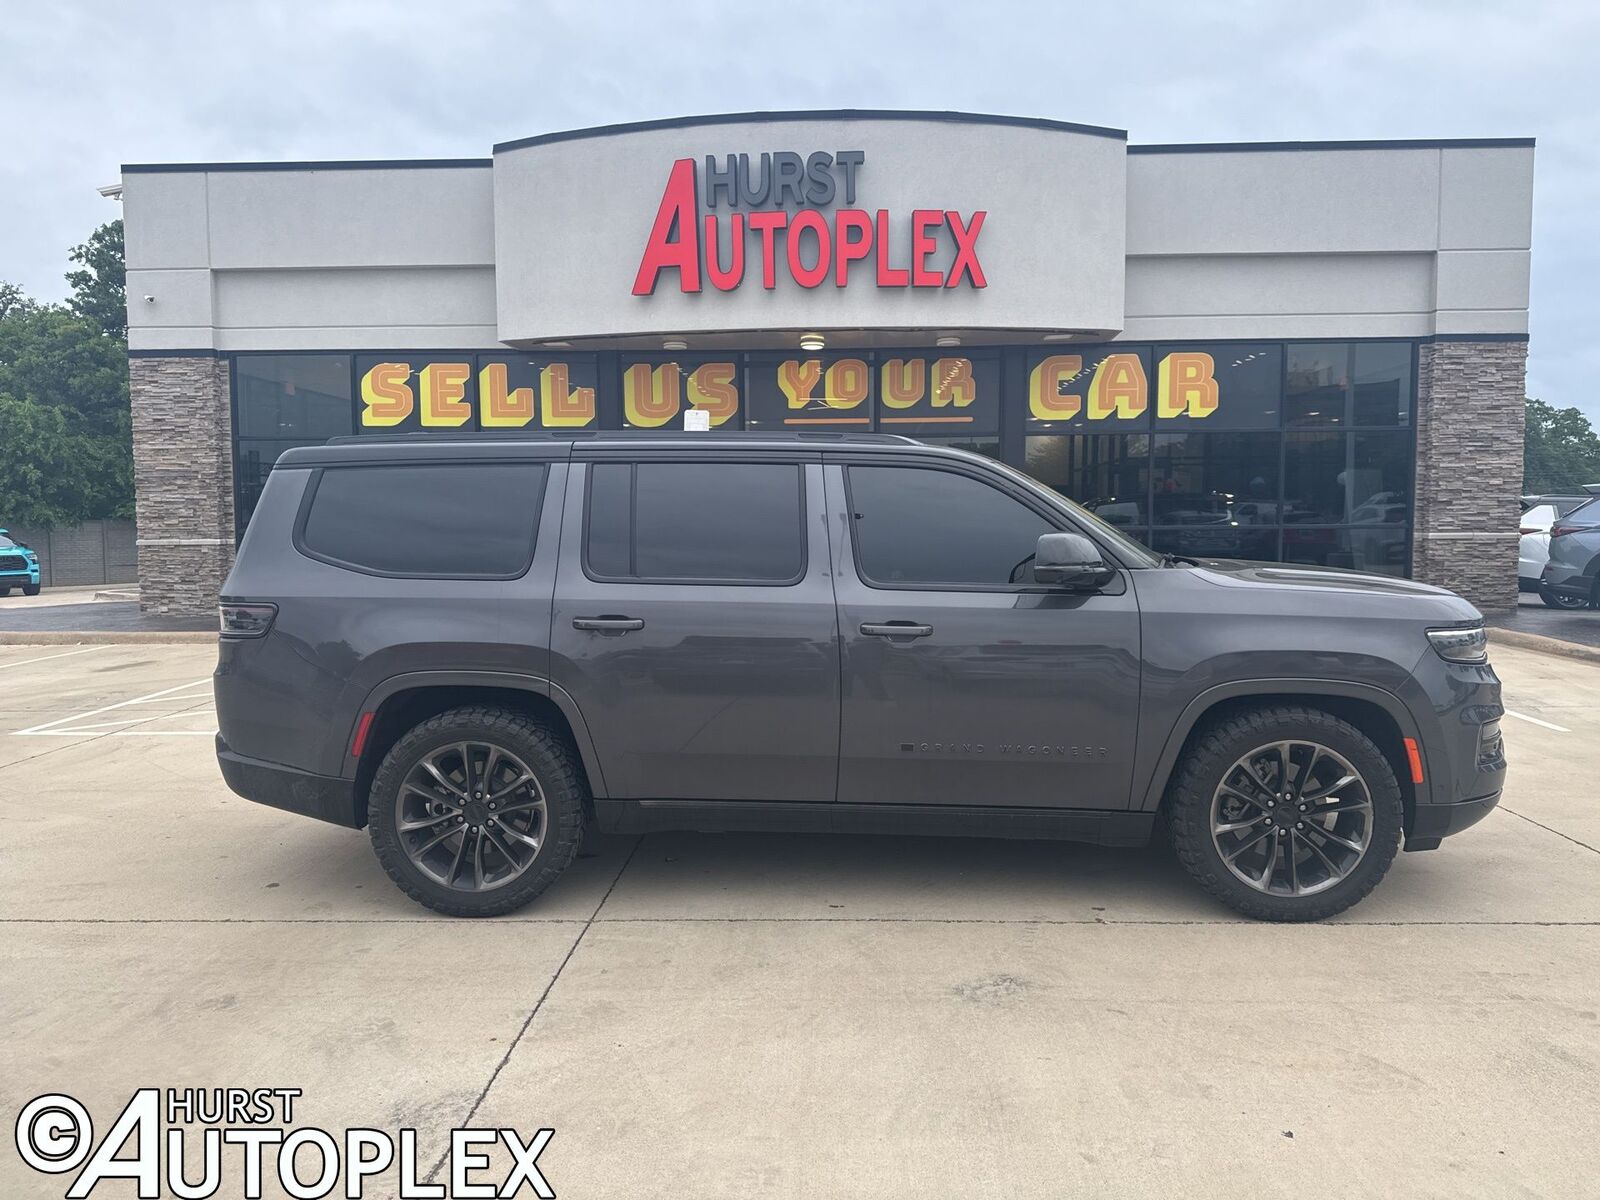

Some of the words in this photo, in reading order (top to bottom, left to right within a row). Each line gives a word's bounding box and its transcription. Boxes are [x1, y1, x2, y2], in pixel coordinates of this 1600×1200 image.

[706, 150, 865, 207] HURST
[632, 158, 988, 296] AUTOPLEX
[361, 362, 596, 428] SELL
[623, 362, 740, 429] US
[777, 357, 977, 410] YOUR
[1029, 351, 1219, 421] CAR
[999, 743, 1109, 757] WAGONEER
